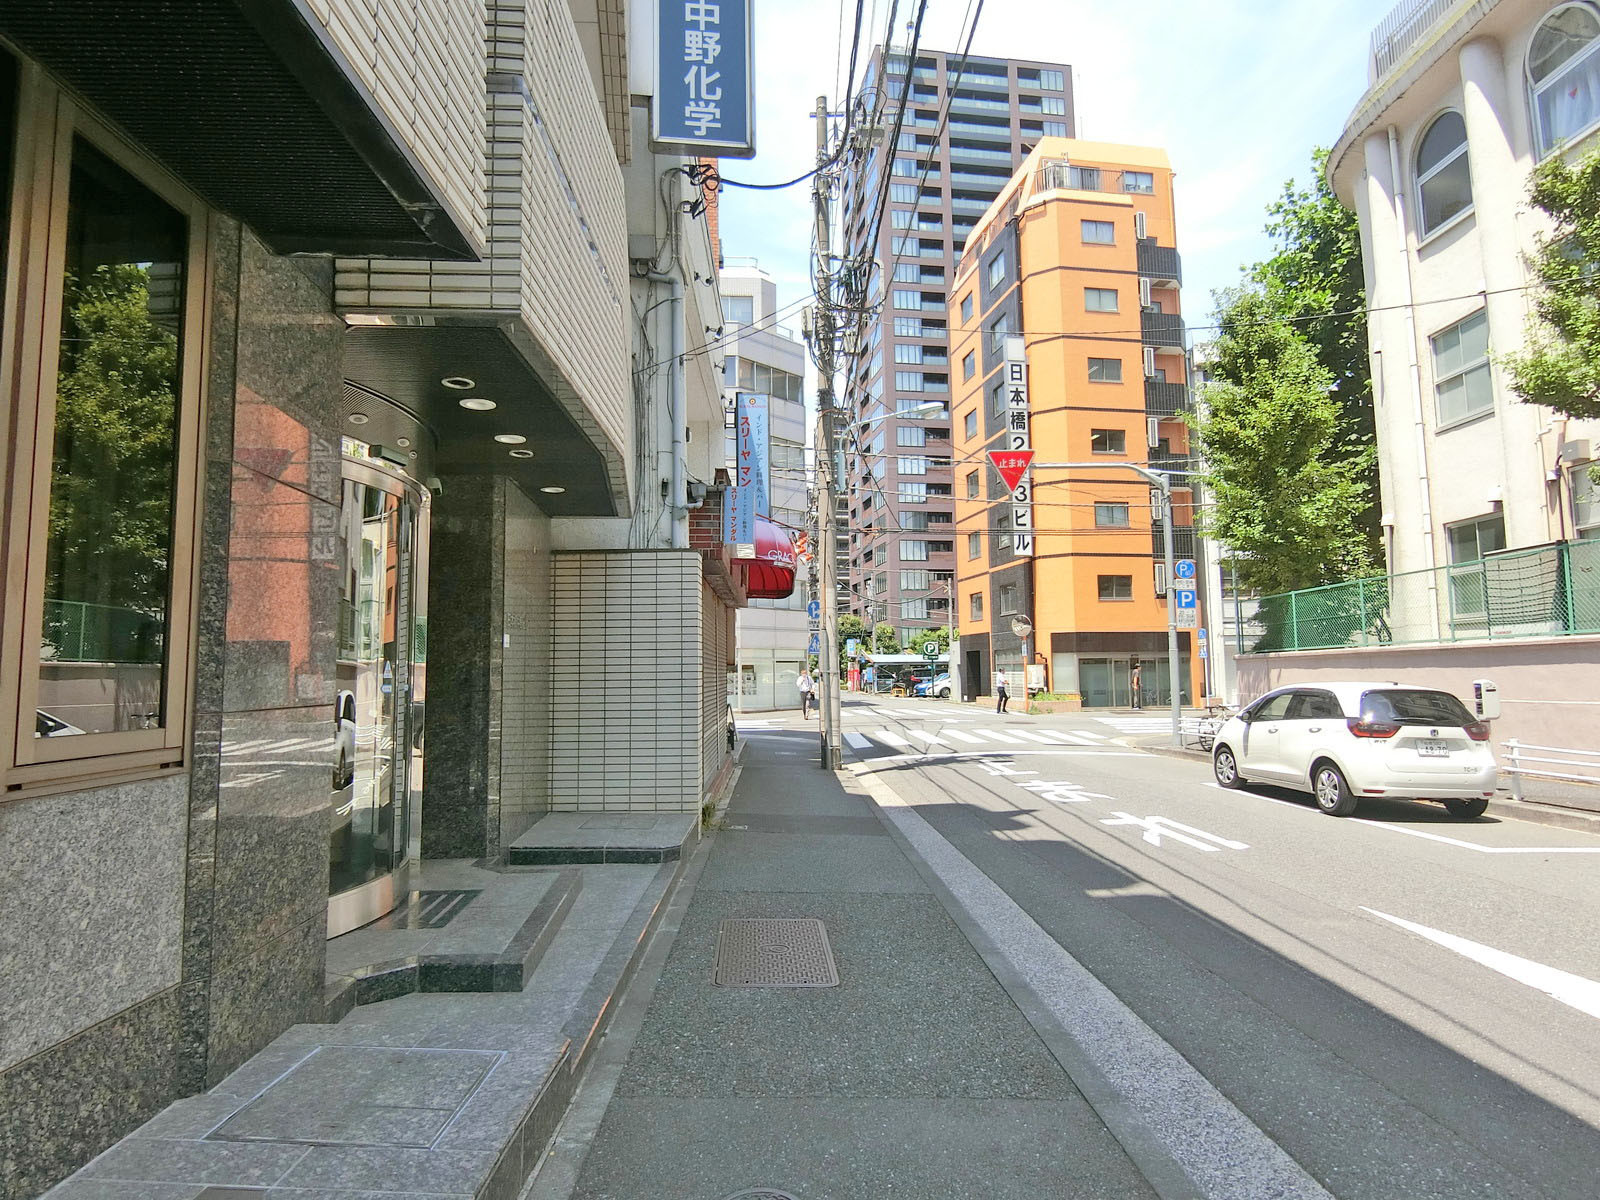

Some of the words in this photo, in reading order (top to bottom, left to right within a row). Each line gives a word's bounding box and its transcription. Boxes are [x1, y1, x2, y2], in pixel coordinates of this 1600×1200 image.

[684, 0, 722, 136] 中野化学
[998, 457, 1026, 469] 止まれ
[1009, 363, 1030, 551] 日本橋23ビル
[1181, 592, 1192, 606] P
[977, 758, 1251, 852] 止まれ
